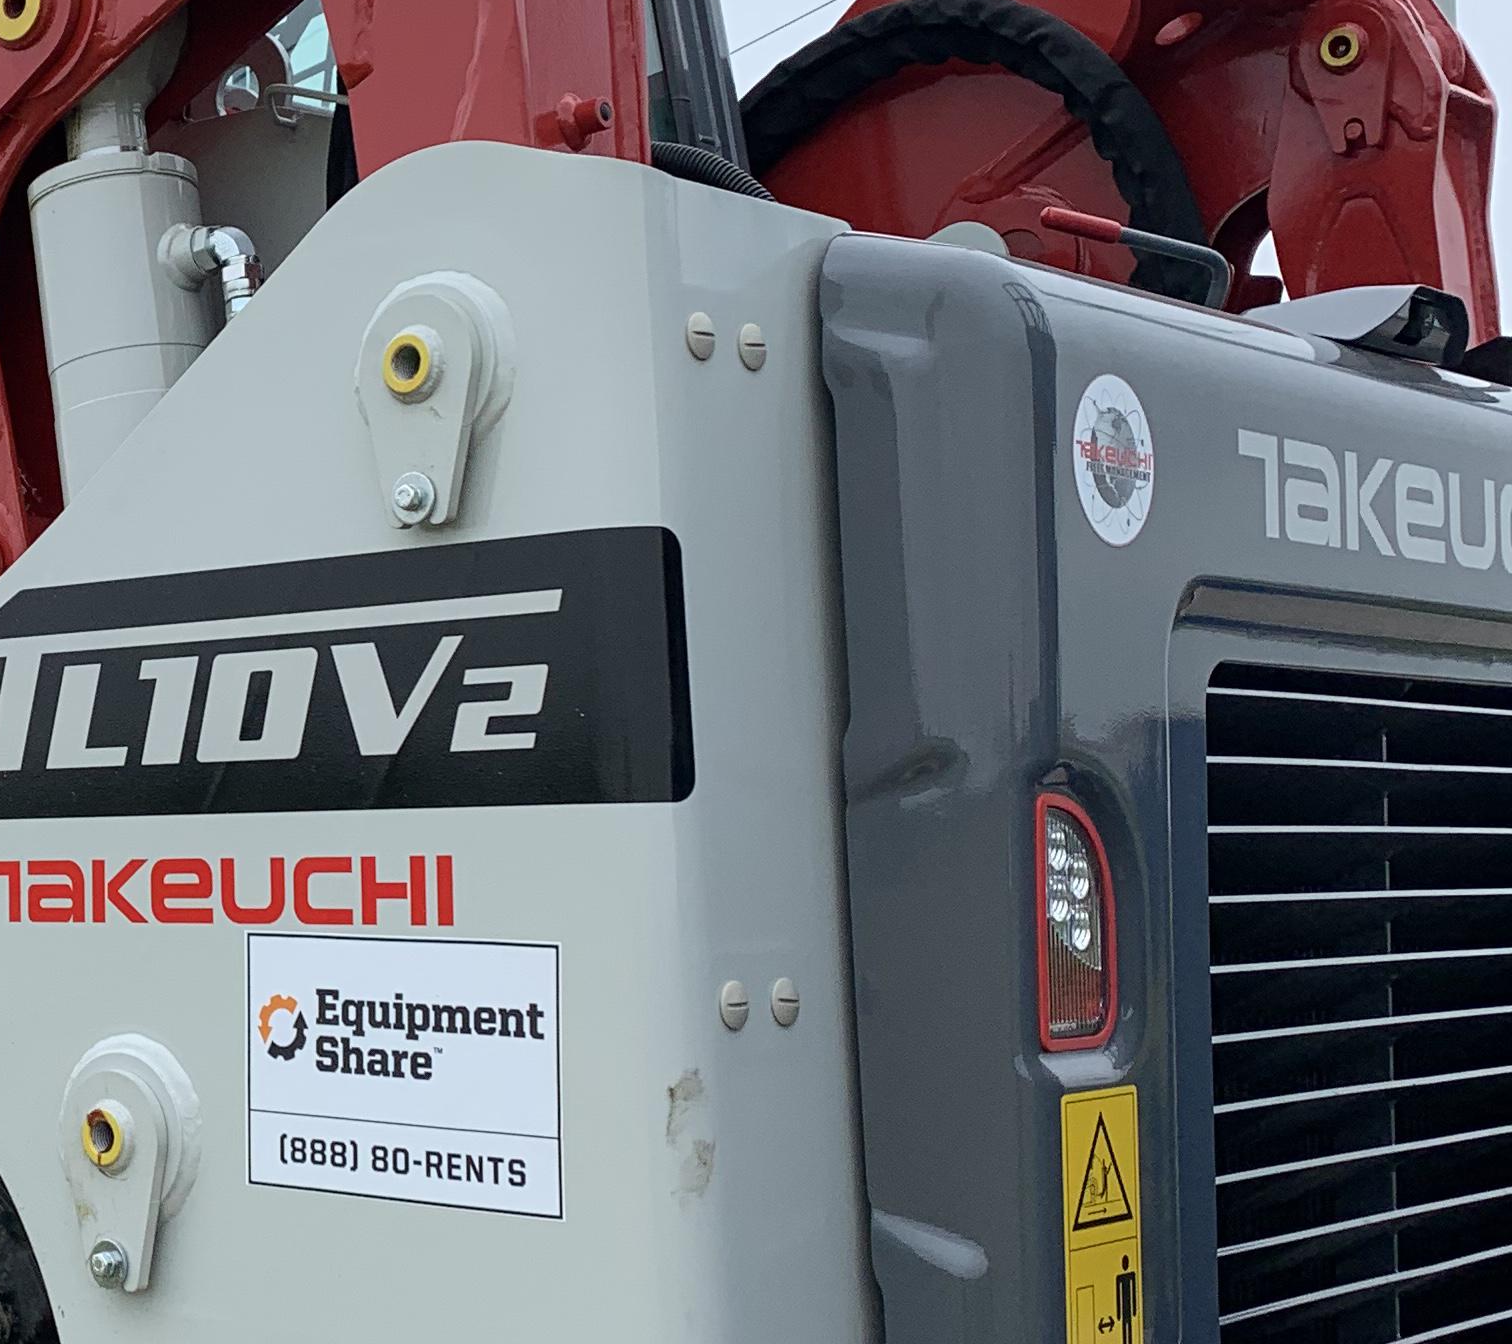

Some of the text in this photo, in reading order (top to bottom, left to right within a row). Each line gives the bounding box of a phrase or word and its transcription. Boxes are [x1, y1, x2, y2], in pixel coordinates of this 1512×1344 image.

[1237, 427, 1512, 572] TAKEU
[315, 988, 545, 1041] Equipment
[315, 1035, 433, 1081] Share
[279, 1133, 527, 1188] (888) 80-RENTS
